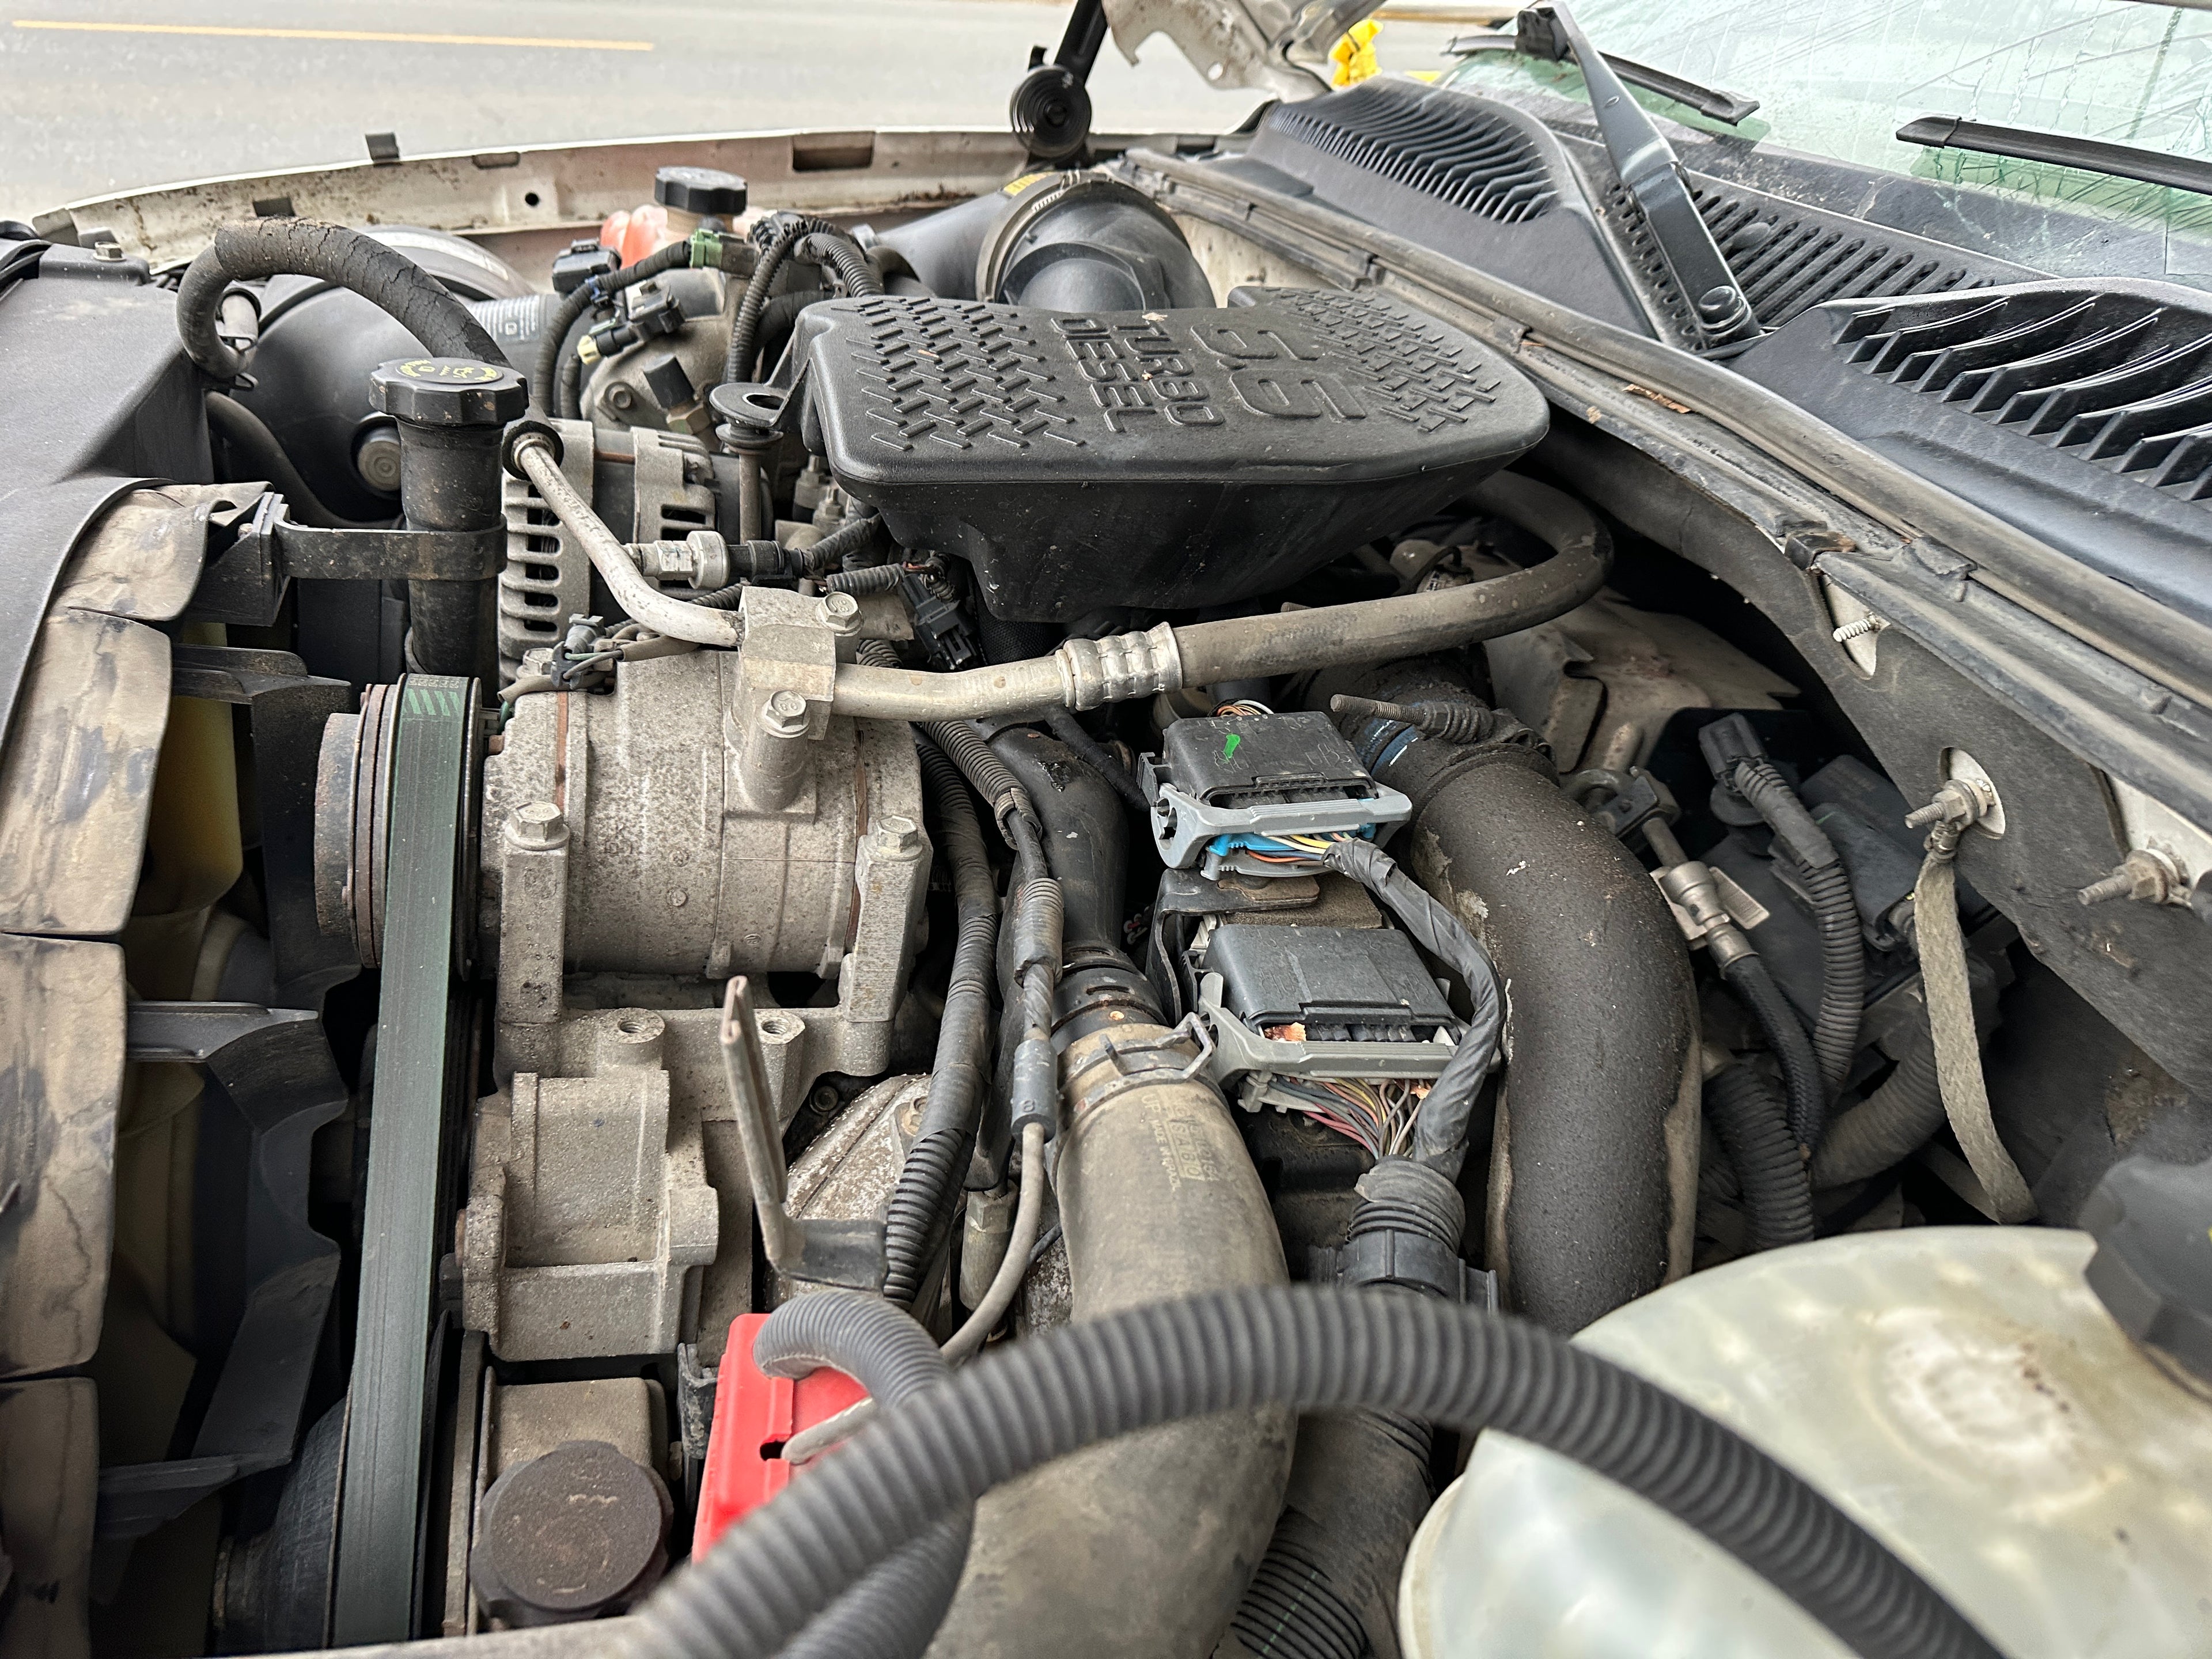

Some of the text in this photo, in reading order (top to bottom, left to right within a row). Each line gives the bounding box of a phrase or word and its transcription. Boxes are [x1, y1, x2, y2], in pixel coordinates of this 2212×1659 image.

[1050, 317, 1159, 433] DIESEL
[1113, 320, 1226, 427] TURBO
[1191, 323, 1367, 420] 6.6
[1149, 1119, 1181, 1192] MADE IN BRAZIL
